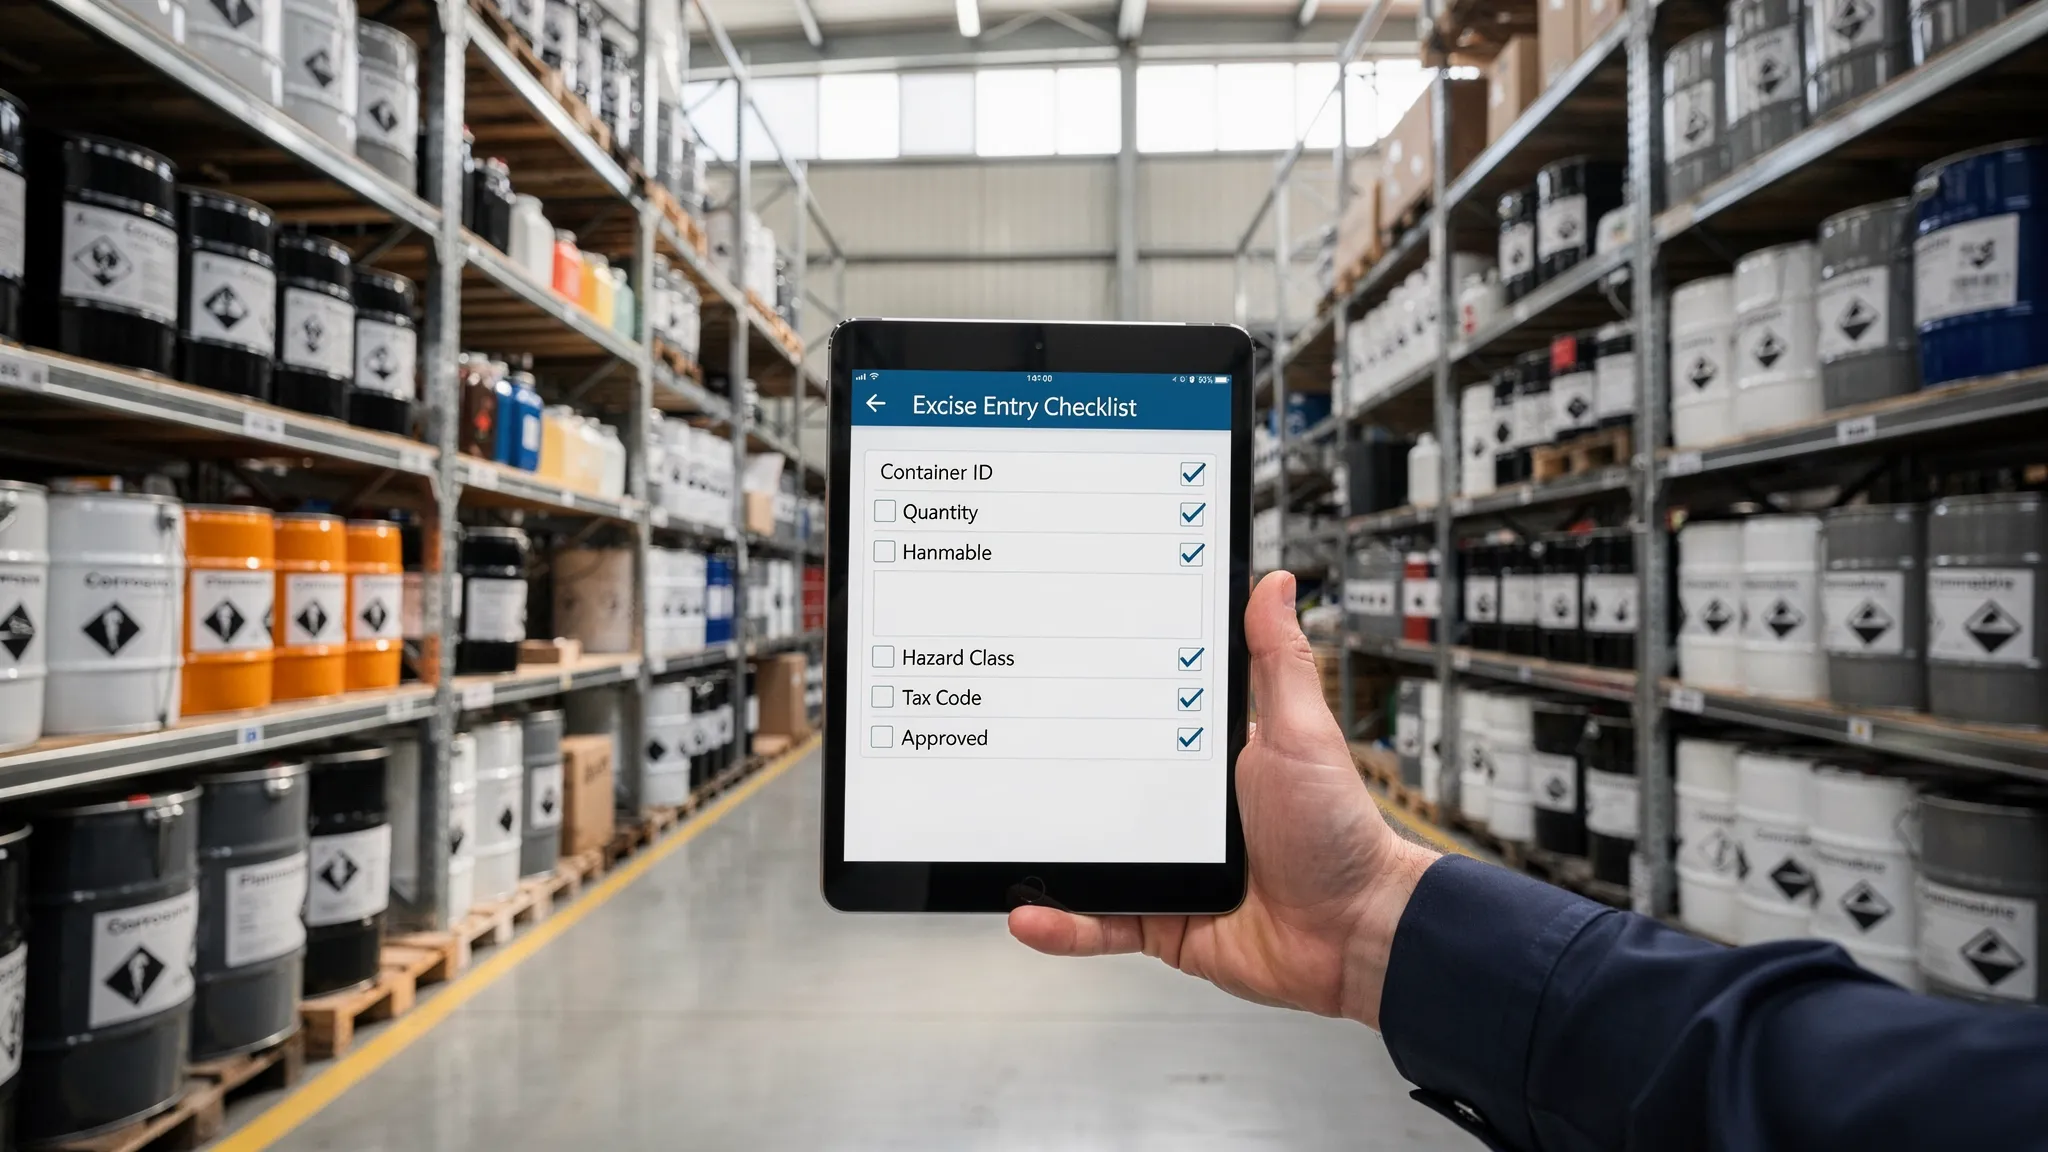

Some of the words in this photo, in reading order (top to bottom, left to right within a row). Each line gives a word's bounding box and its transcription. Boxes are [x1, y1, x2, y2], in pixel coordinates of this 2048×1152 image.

[913, 394, 977, 416] Excise
[983, 395, 1039, 421] Entry
[1043, 395, 1138, 418] Checklist
[880, 463, 968, 481] Container
[973, 464, 993, 481] ID
[902, 503, 979, 525] Quantity
[903, 543, 993, 561] Hanmable
[902, 648, 964, 666] Hazard
[969, 648, 1015, 667] Class
[902, 688, 932, 706] Tax
[935, 689, 983, 706] Code
[900, 728, 988, 751] Approved
